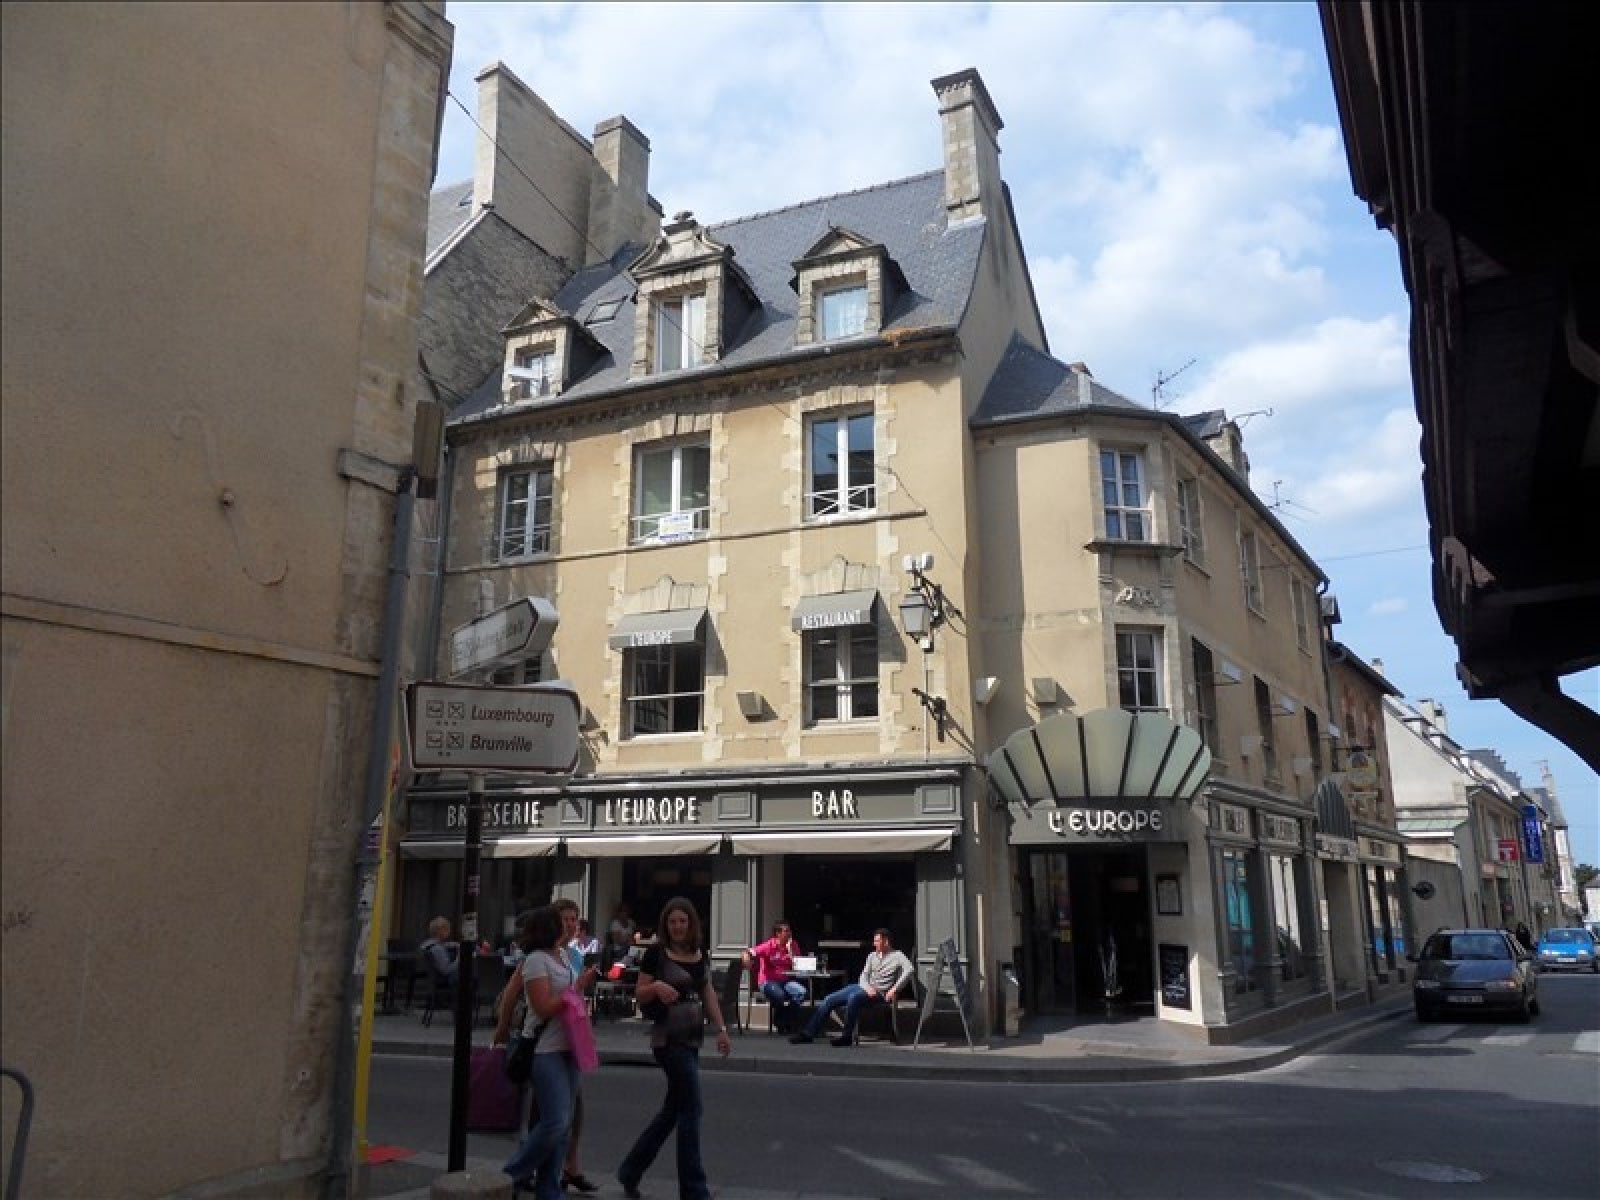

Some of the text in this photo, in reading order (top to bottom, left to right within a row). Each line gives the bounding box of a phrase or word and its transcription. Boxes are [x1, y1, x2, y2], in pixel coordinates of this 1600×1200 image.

[630, 630, 672, 647] L'EUROPE
[471, 703, 555, 728] Luxembourg
[470, 733, 533, 752] Brunville
[447, 801, 541, 827] BRSSERIE
[605, 796, 698, 823] L'EUROPE
[811, 789, 856, 817] BAR
